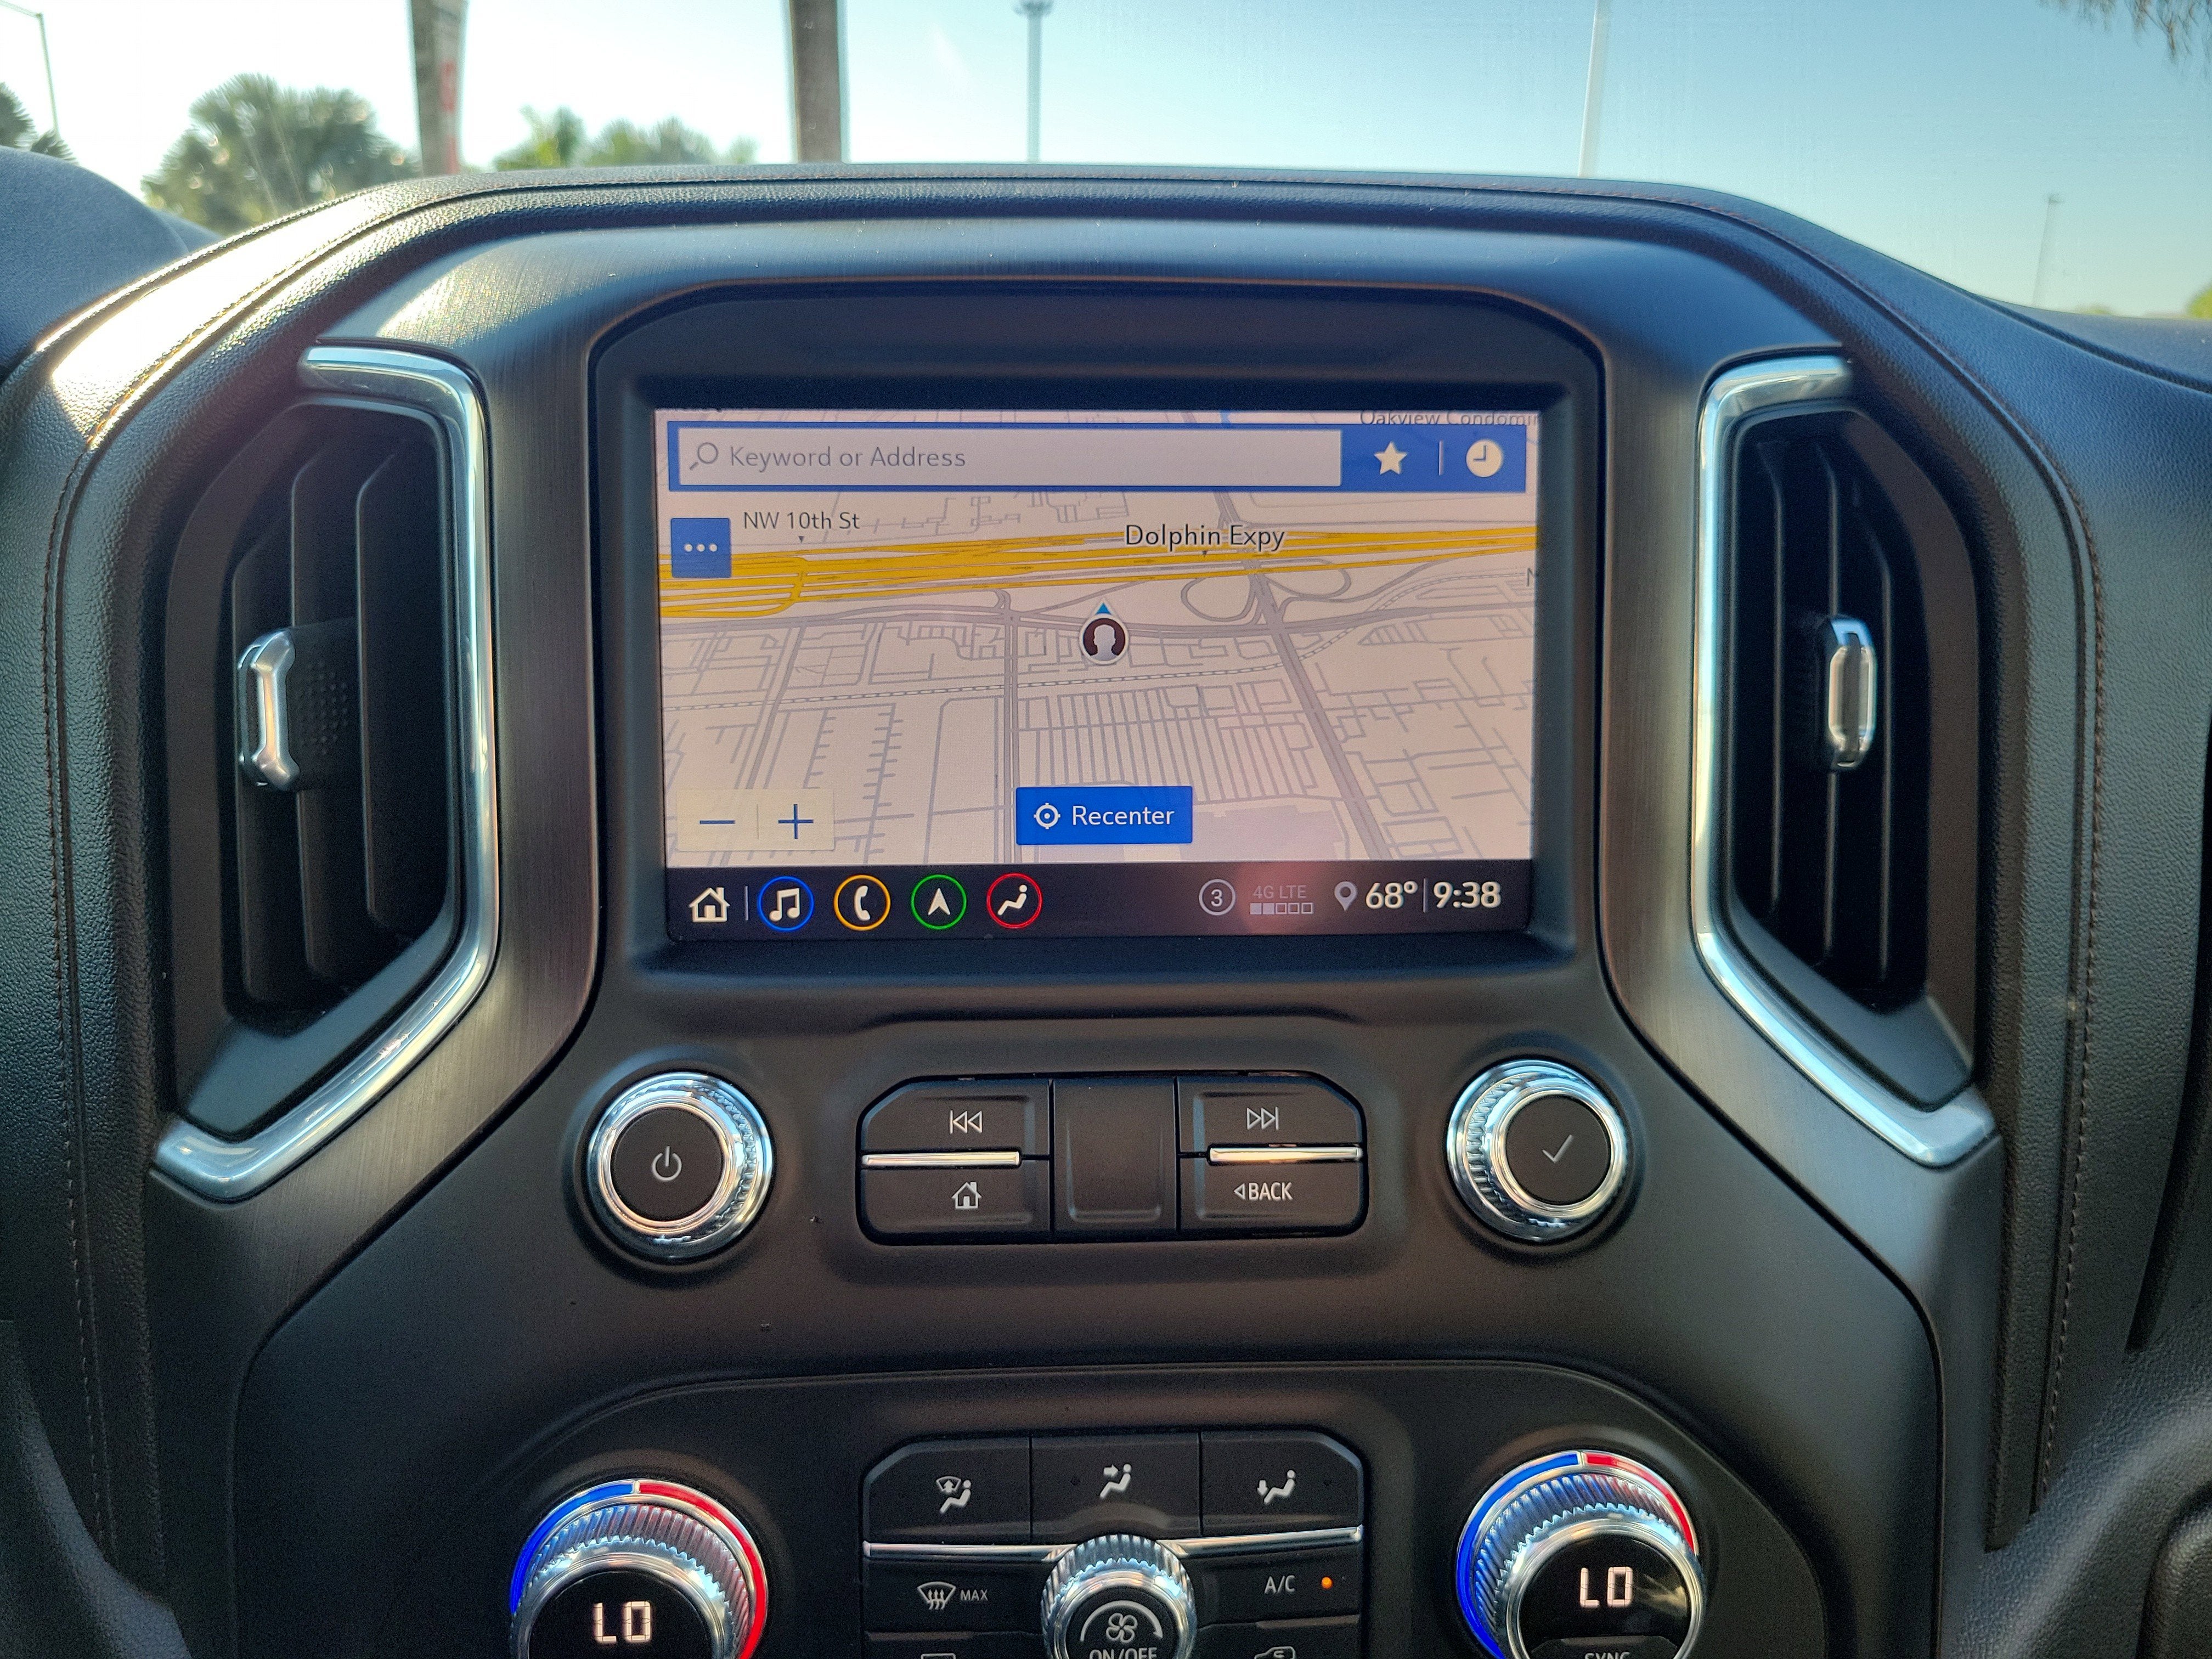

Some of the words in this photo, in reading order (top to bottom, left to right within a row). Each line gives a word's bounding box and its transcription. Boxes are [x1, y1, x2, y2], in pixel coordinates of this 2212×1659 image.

[730, 446, 831, 473] Keyword
[839, 452, 864, 467] or
[870, 446, 966, 467] Address
[743, 512, 780, 529] NW
[787, 511, 832, 529] 10th
[839, 512, 860, 529] St
[1126, 524, 1220, 552] Dolphin
[1230, 524, 1285, 552] Expy
[1073, 805, 1175, 826] Recenter
[1211, 889, 1223, 907] 3
[1253, 885, 1274, 899] 4G
[1279, 884, 1307, 899] LTE
[1433, 881, 1502, 909] 9:38
[1249, 1182, 1294, 1201] BACK
[1264, 1575, 1295, 1594] A/C
[1579, 1566, 1634, 1609] LO
[960, 1589, 988, 1601] MAX
[594, 1600, 651, 1644] LO
